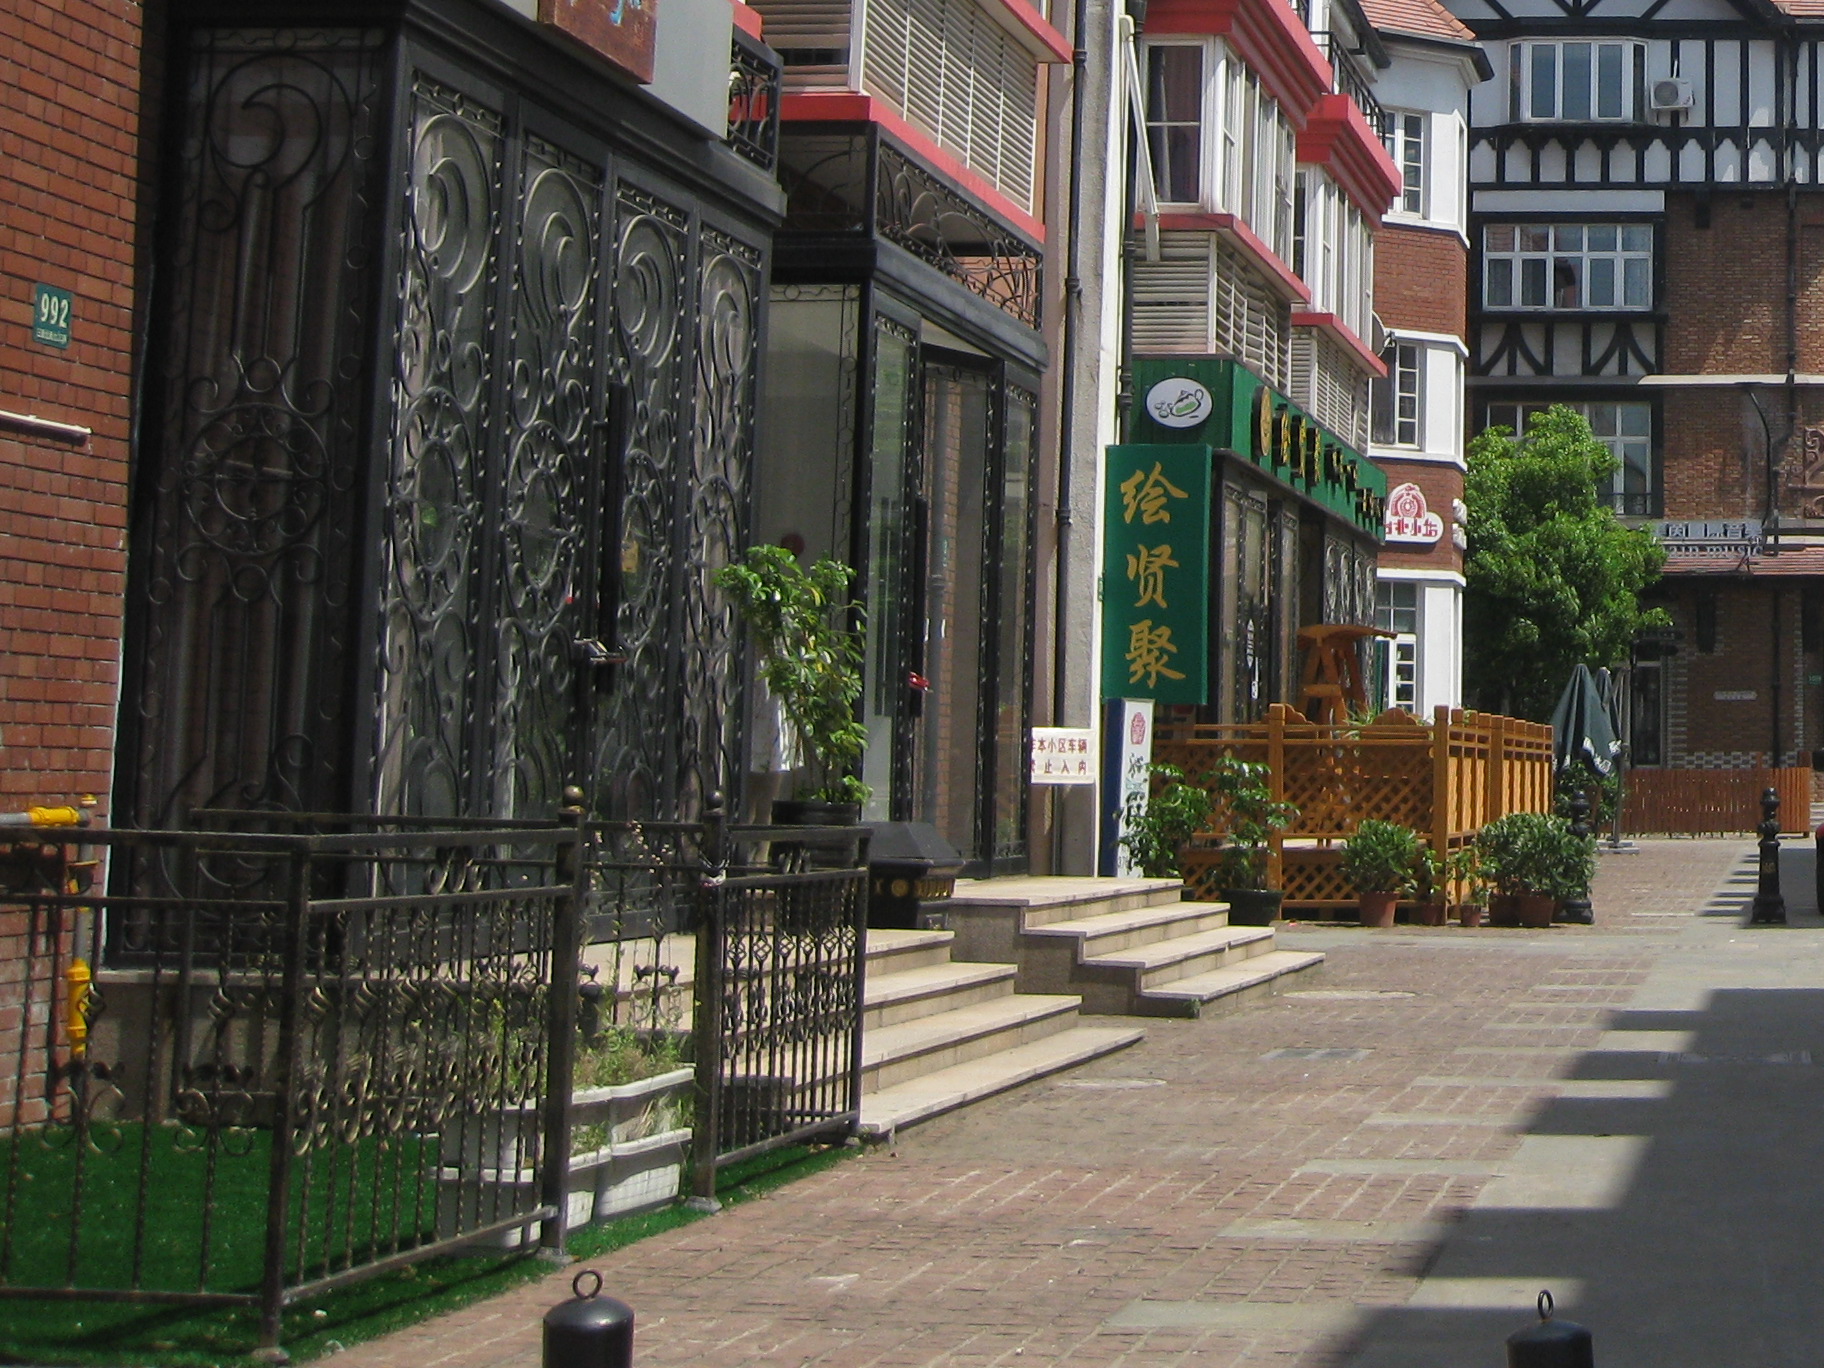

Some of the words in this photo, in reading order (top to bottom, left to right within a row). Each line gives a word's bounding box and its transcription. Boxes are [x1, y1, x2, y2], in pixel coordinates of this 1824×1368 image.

[41, 293, 69, 328] 992
[1119, 461, 1190, 690] 绘贤聚
